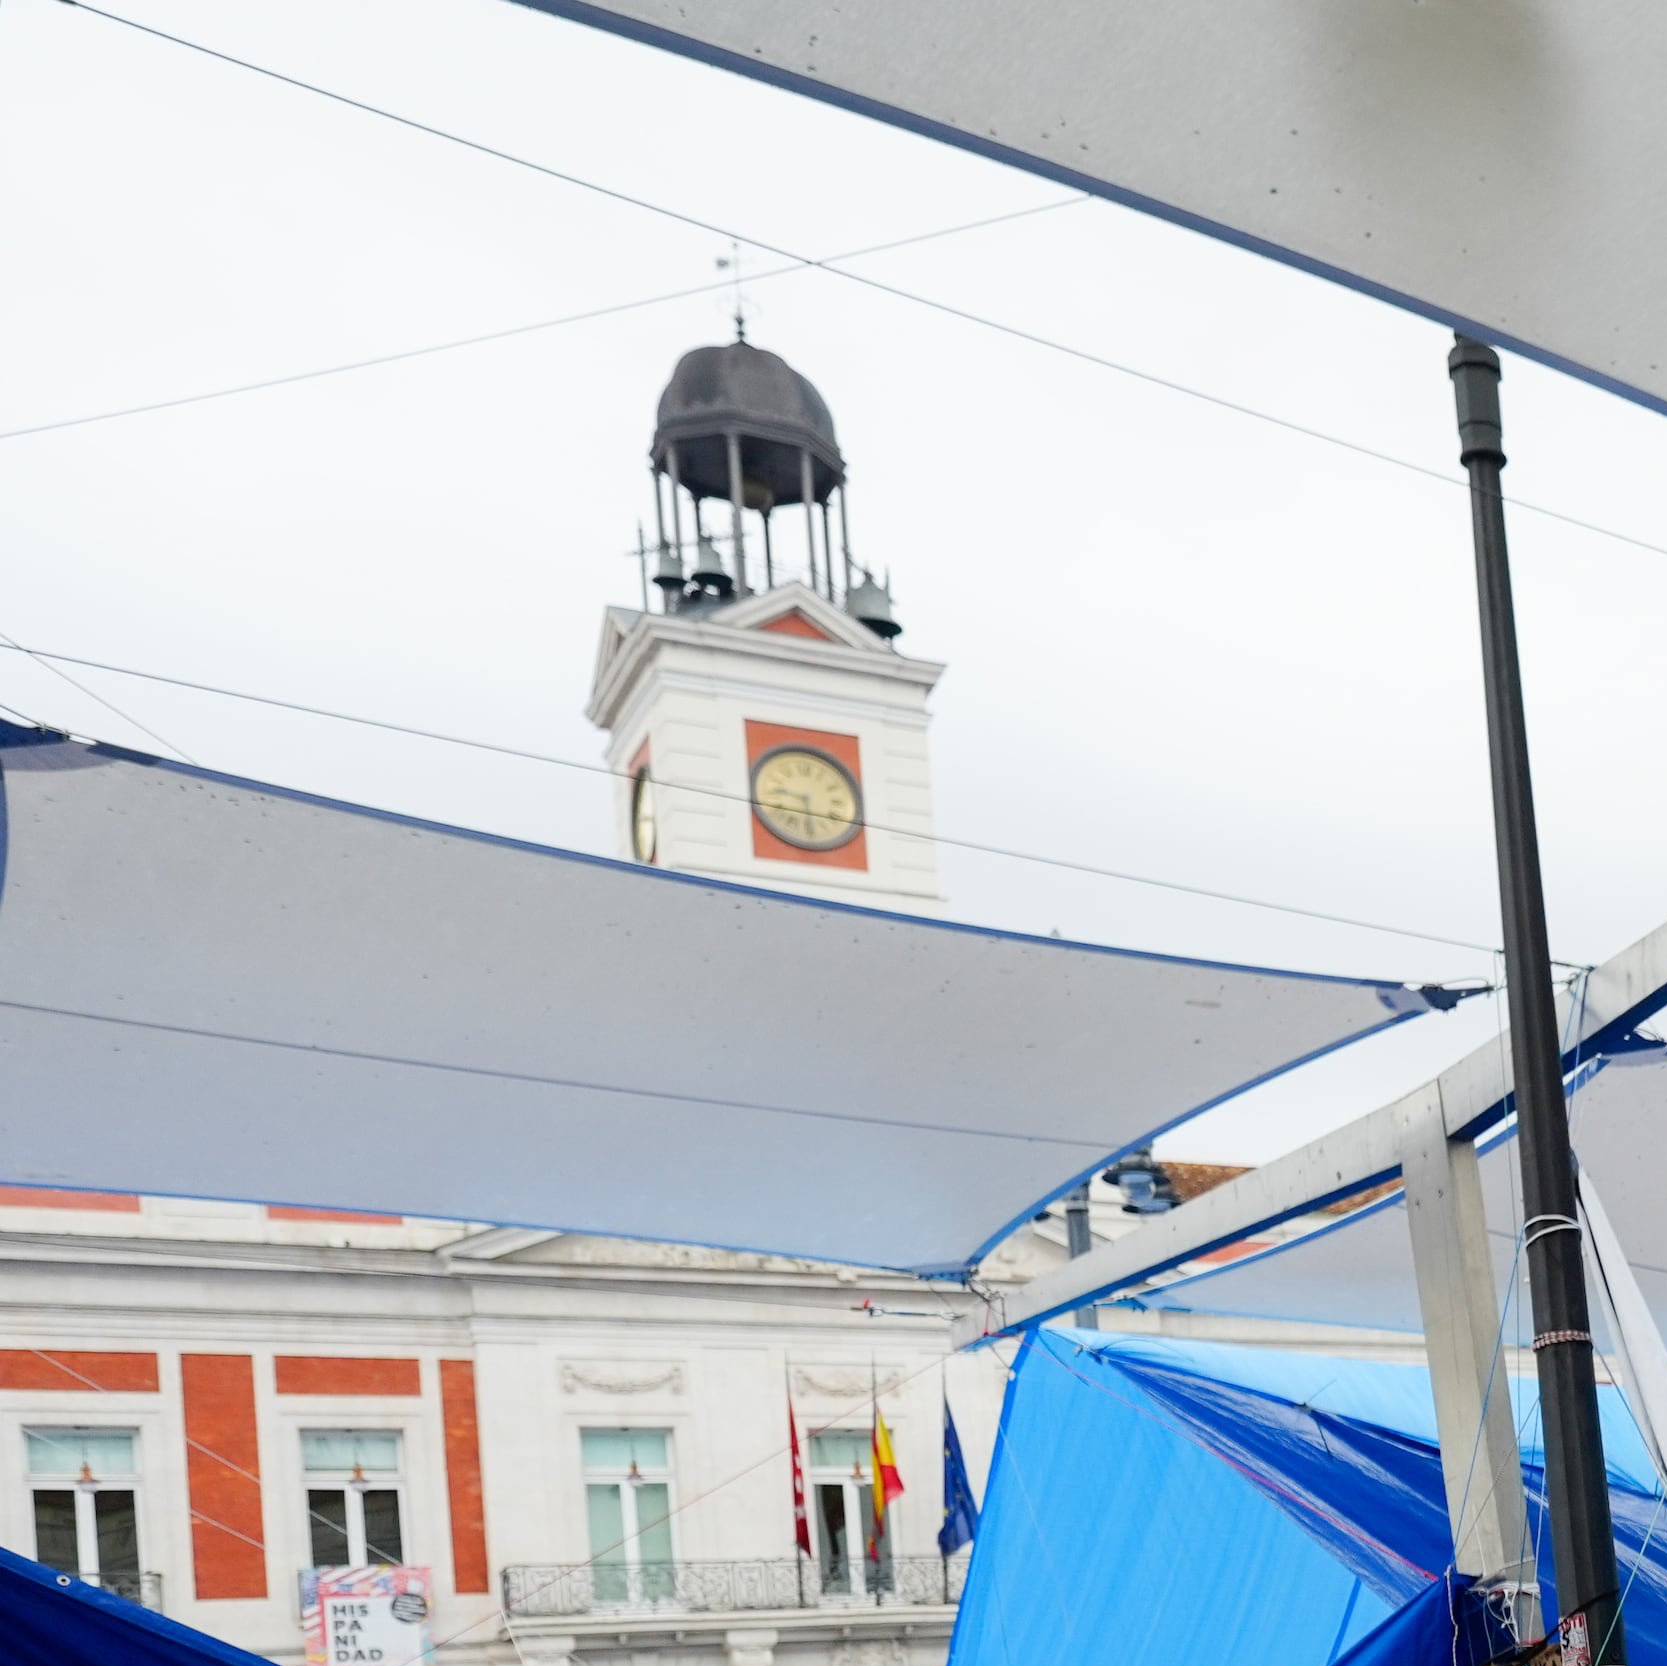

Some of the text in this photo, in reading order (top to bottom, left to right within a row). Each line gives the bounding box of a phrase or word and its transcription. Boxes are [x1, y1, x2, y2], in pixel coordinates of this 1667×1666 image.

[332, 1604, 369, 1617] HIS
[333, 1620, 363, 1632] PA
[334, 1635, 358, 1647] NI
[335, 1650, 384, 1662] DAD
